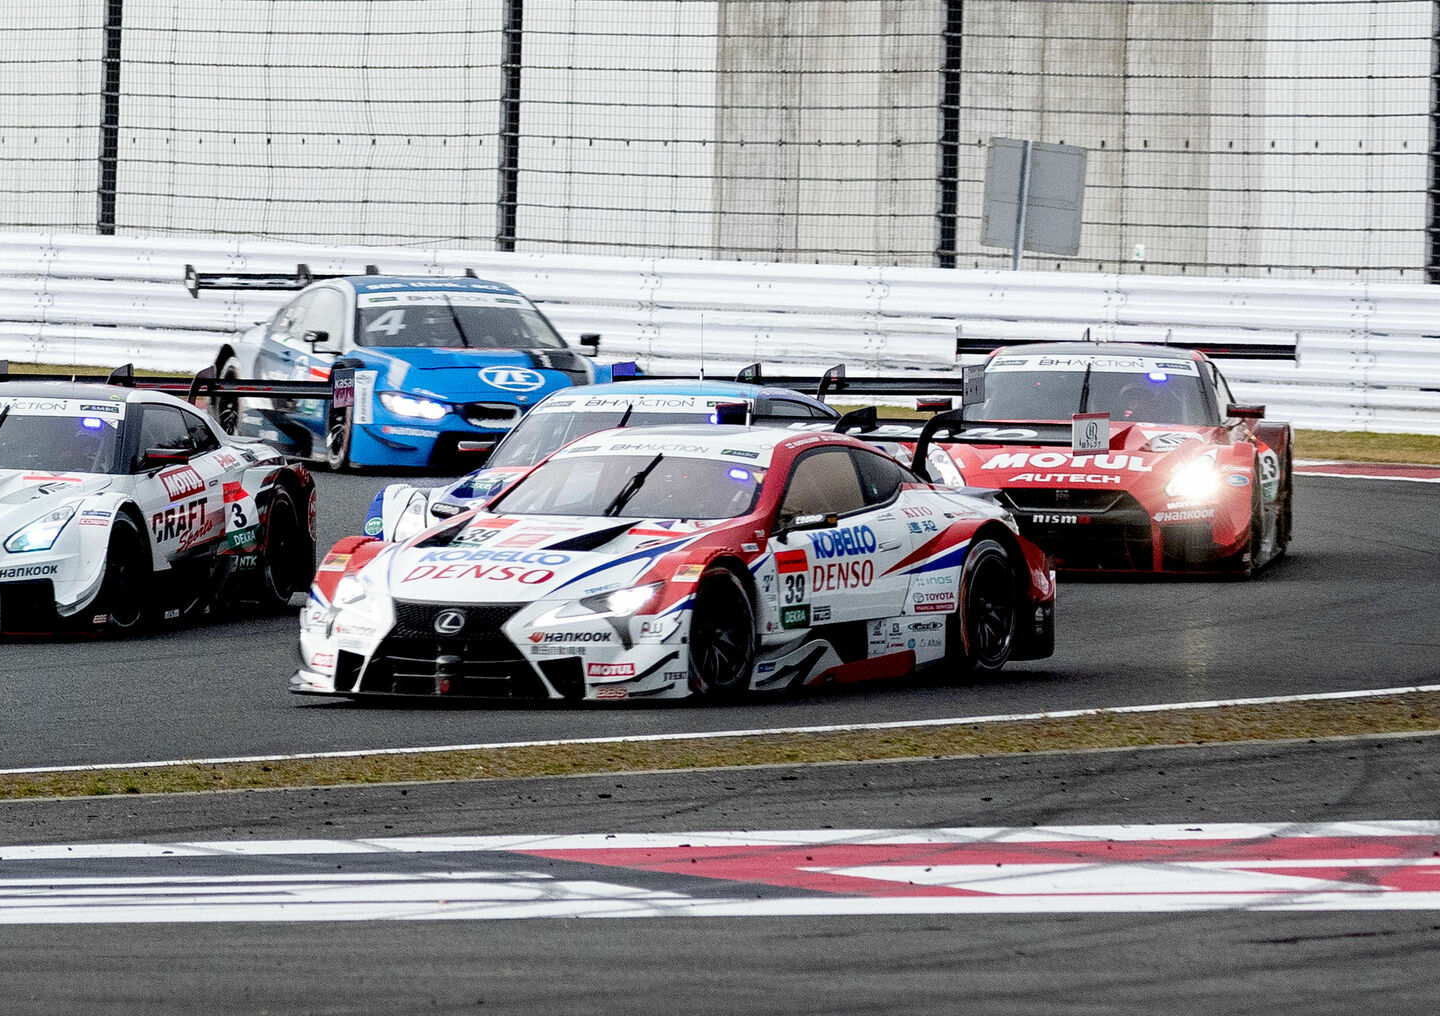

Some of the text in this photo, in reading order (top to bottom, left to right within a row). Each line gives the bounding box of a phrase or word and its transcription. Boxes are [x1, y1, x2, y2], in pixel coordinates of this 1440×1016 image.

[365, 309, 407, 336] 4
[89, 404, 120, 414] SMBC
[981, 453, 1154, 473] MOTUL
[162, 467, 203, 498] MOTUL
[1008, 472, 1121, 484] AUTECH
[152, 496, 208, 544] CRAFT
[231, 502, 248, 528] 3
[901, 506, 933, 519] KITO
[459, 528, 499, 542] 39
[806, 524, 877, 560] KOBELCO
[239, 554, 258, 567] NTK
[418, 550, 571, 566] KOBELCO
[400, 564, 555, 585] DENSO
[812, 559, 875, 593] DENSO
[785, 574, 806, 604] 39
[925, 591, 955, 601] TOYOTA
[588, 664, 635, 676] MOTUL
[596, 687, 627, 699] BBS
